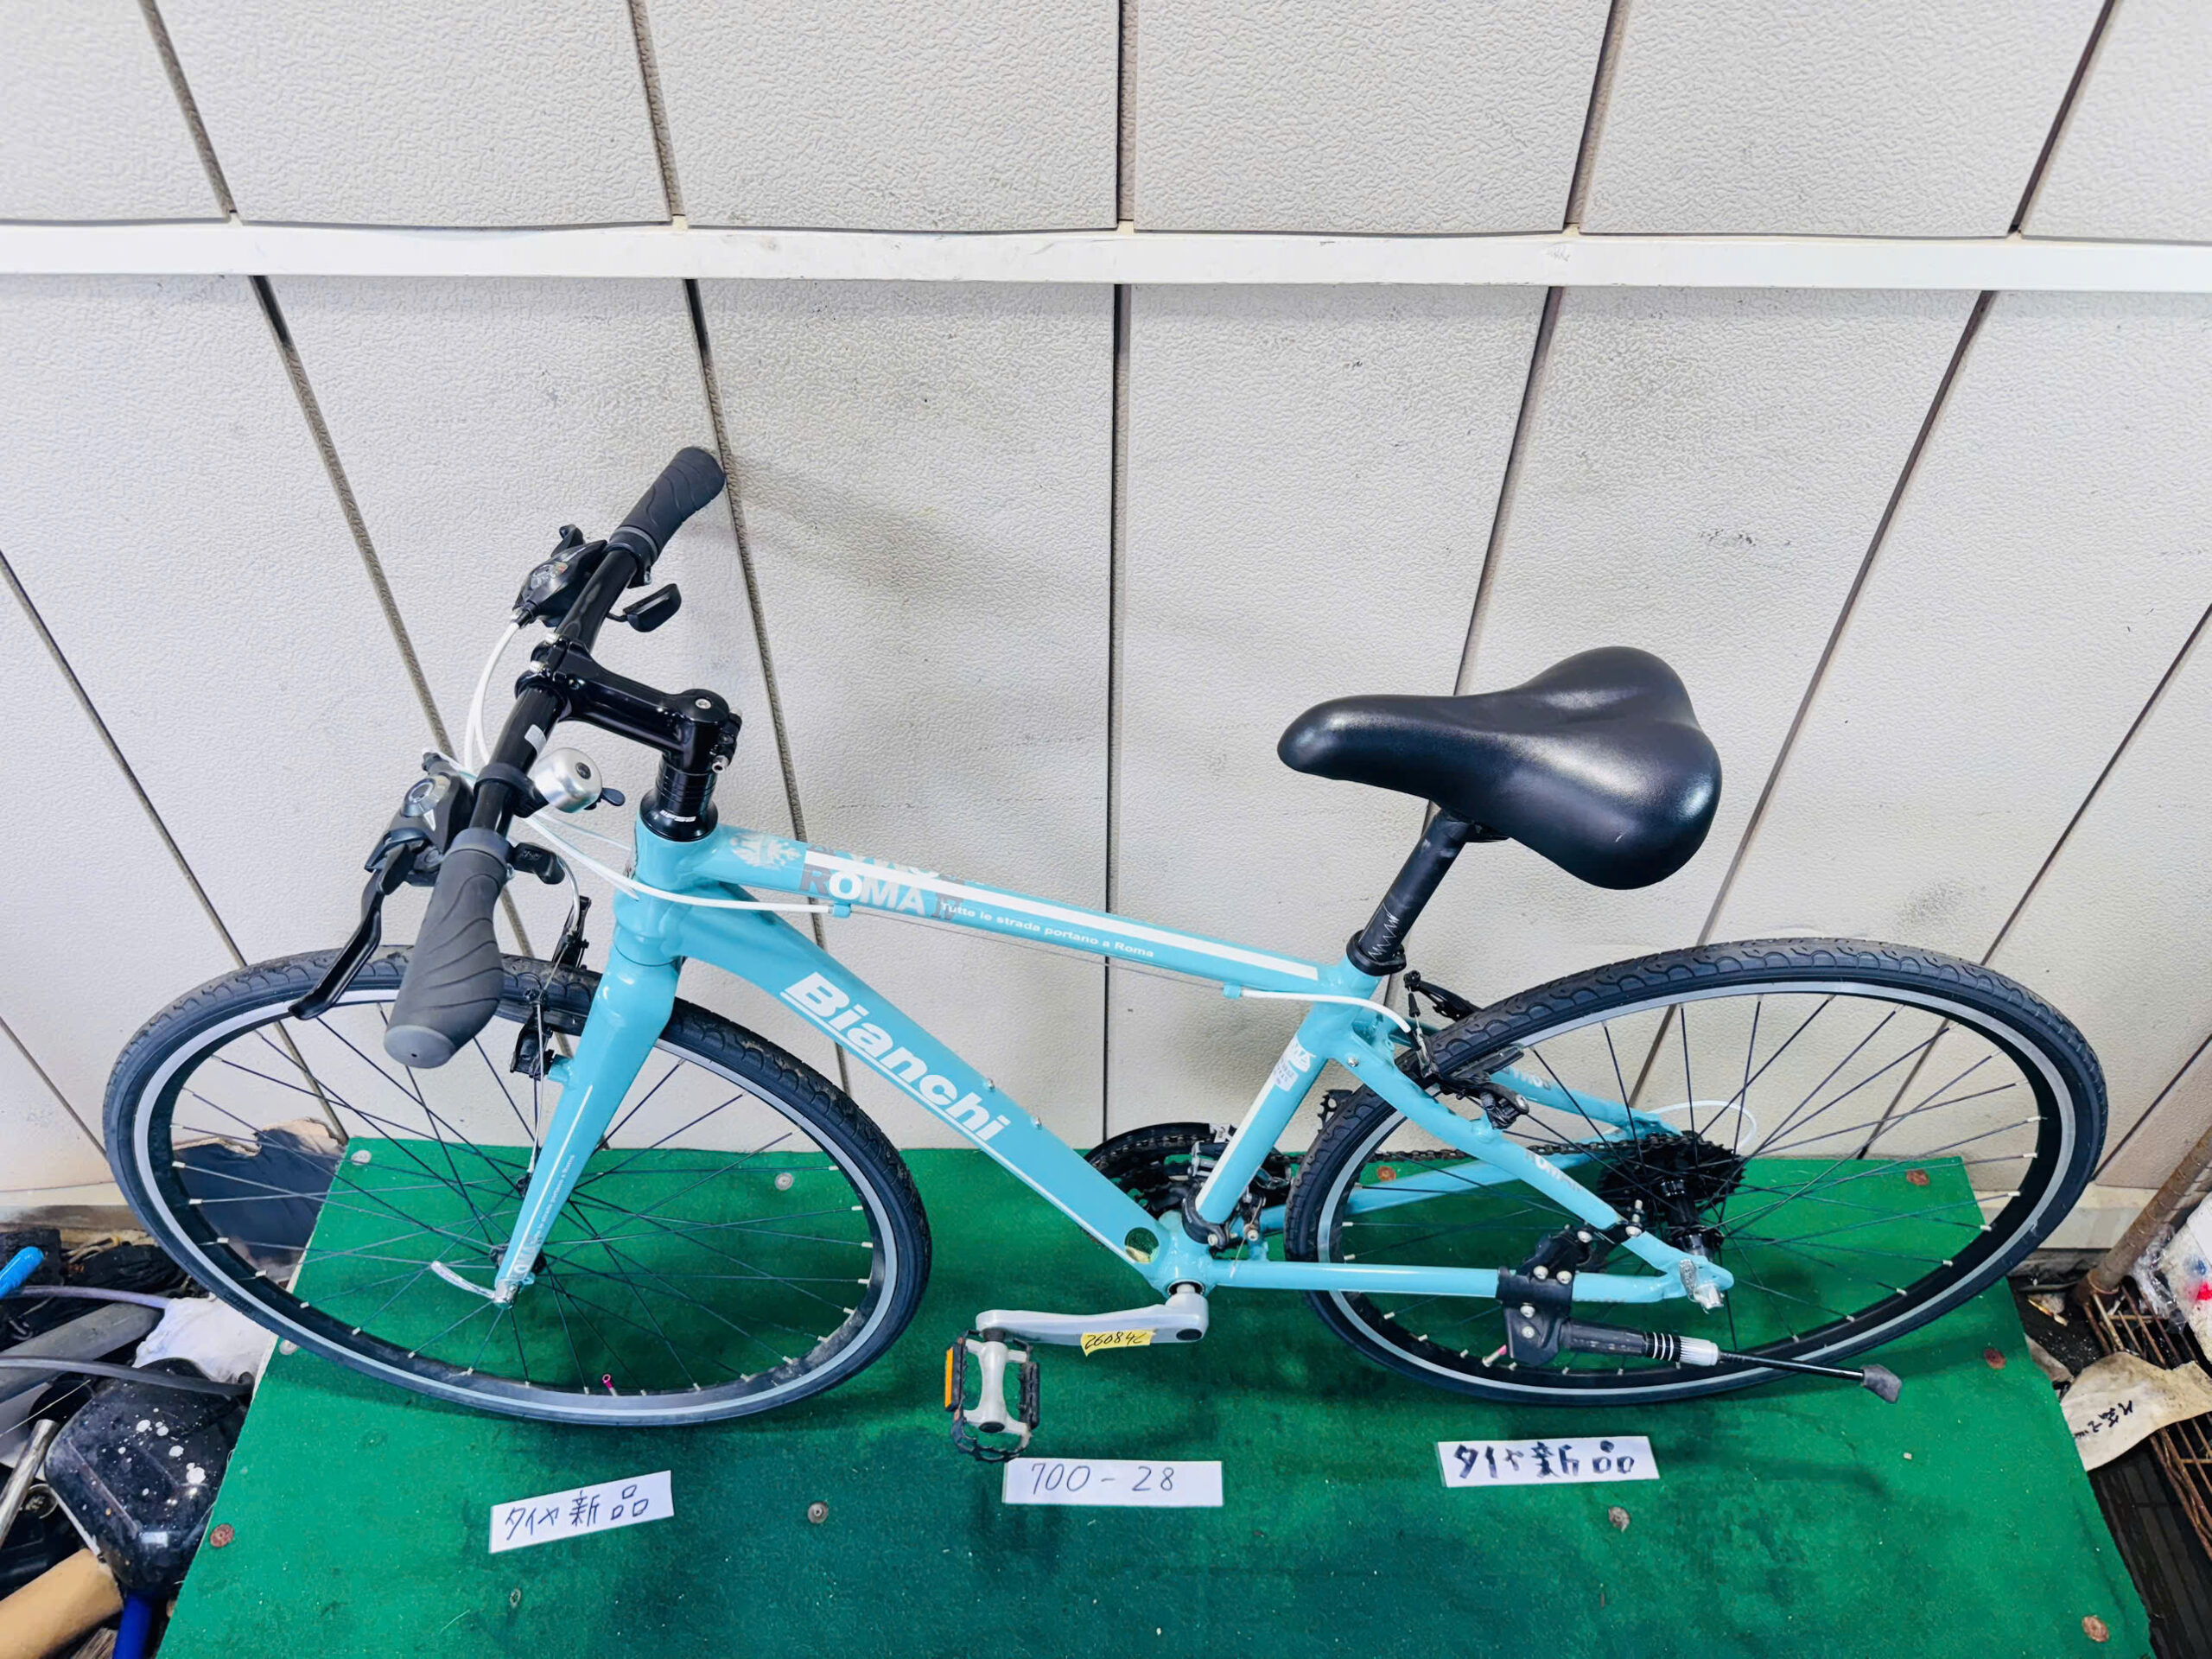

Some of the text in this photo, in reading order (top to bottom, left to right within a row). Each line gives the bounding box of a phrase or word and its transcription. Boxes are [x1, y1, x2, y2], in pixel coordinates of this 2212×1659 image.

[798, 863, 926, 917] ROMA
[940, 901, 976, 918] Tutte
[980, 910, 993, 922] le
[1044, 925, 1099, 946] portano
[1114, 941, 1154, 958] Roma
[784, 971, 1012, 1141] Bianchi
